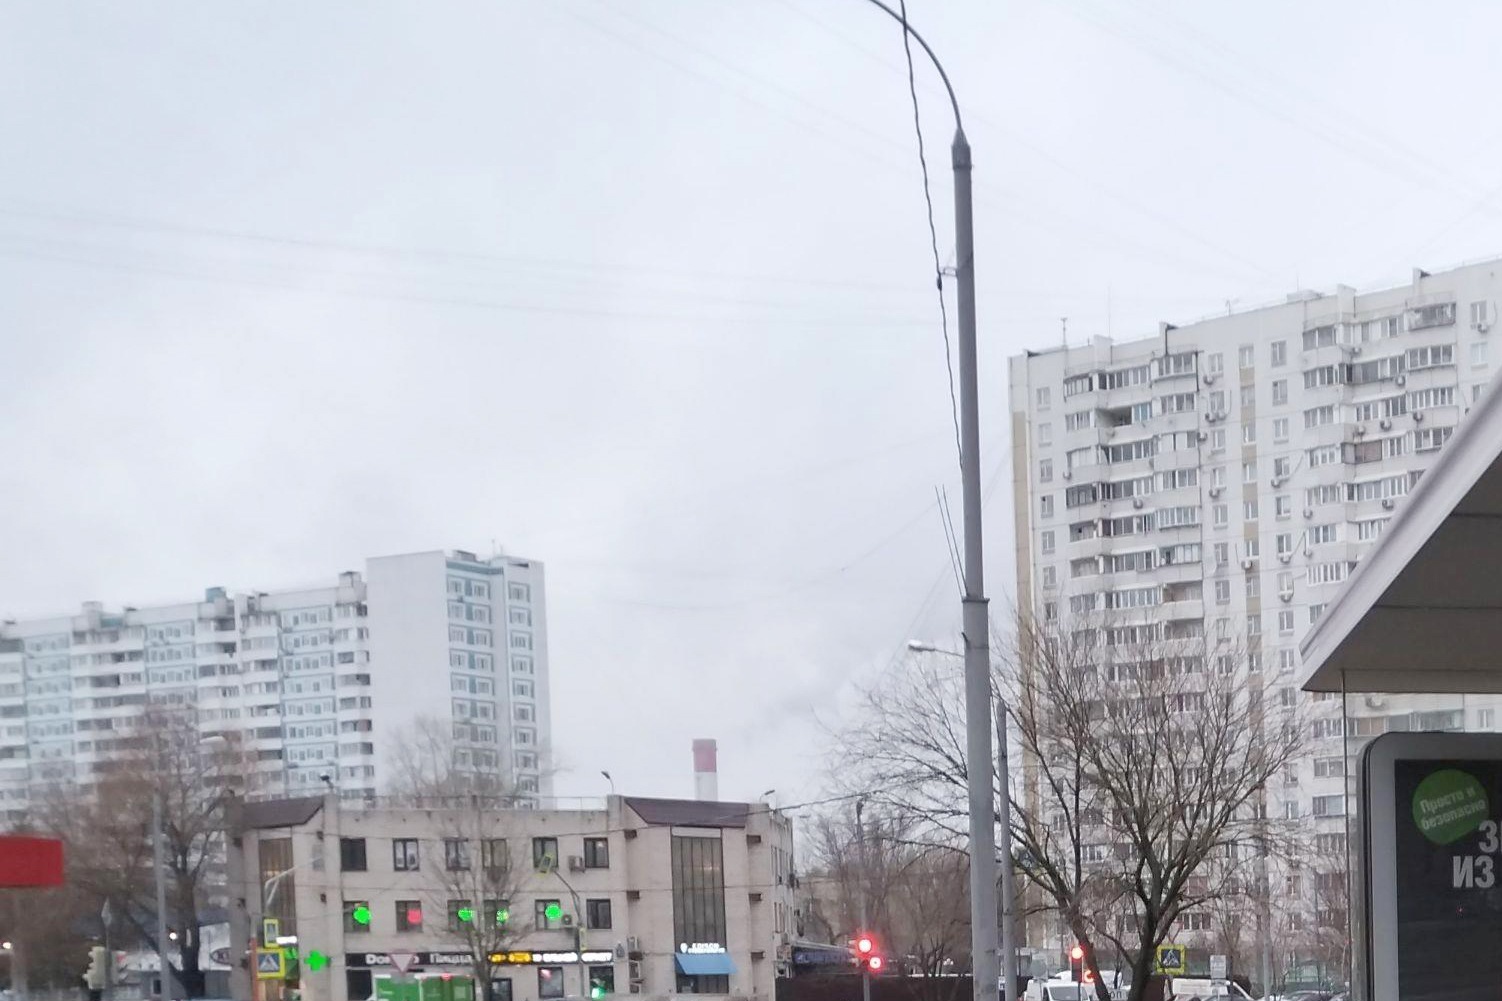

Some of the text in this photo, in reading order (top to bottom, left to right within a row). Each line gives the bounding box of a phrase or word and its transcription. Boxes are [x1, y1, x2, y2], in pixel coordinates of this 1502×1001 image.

[1420, 790, 1465, 815] Просто
[1421, 799, 1487, 831] безопасно
[1452, 855, 1495, 888] ИЗ
